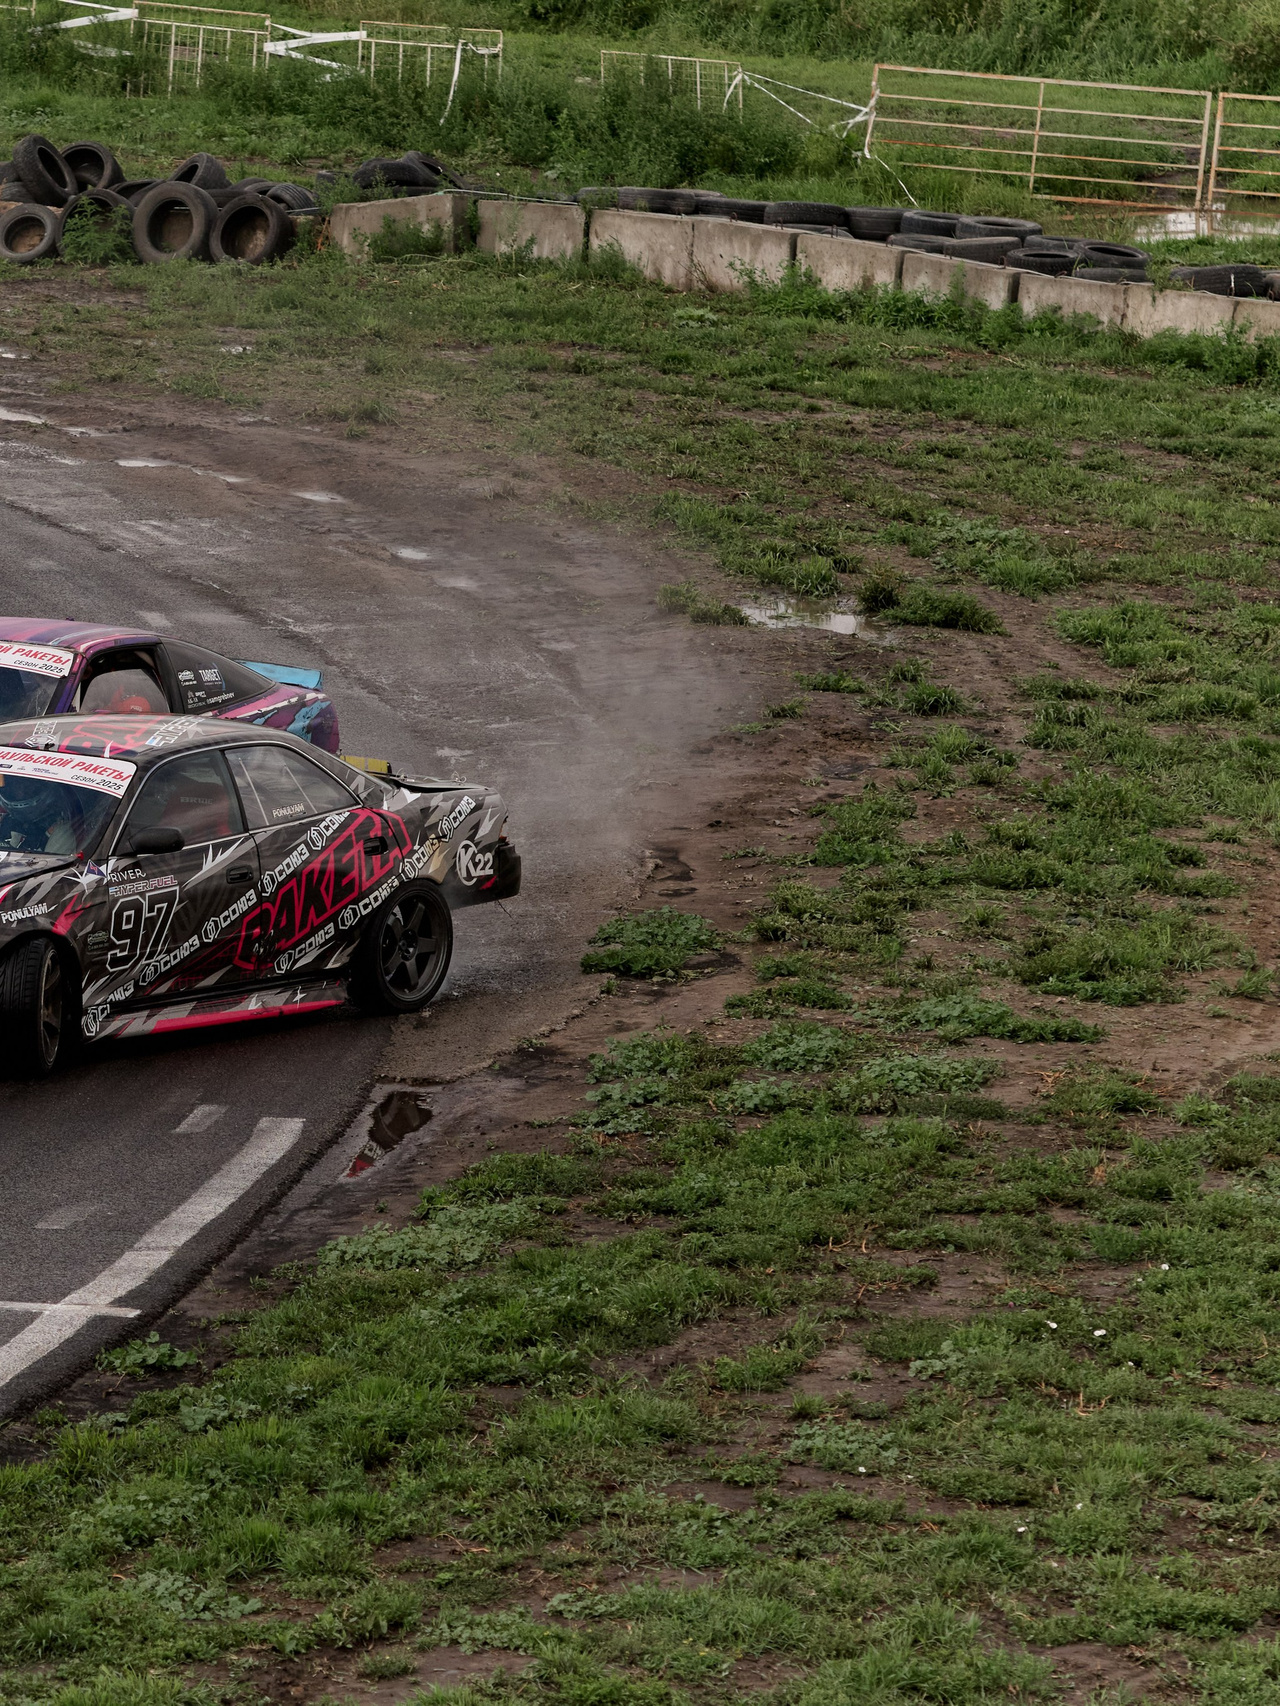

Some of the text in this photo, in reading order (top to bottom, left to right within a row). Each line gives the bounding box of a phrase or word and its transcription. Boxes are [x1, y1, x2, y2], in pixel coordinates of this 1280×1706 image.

[12, 647, 72, 665] РАКЕТЫ
[13, 660, 65, 674] СЕЗОН 2025
[71, 761, 133, 782] РАКЕТЫ
[70, 774, 124, 791] СЕЗОН 2025
[109, 874, 178, 897] HYPER FUEL
[110, 868, 147, 883] RIVER
[0, 903, 49, 924] PONULYAM
[158, 934, 200, 973] СОЮЗ
[219, 888, 258, 929] СОЮЗ
[275, 843, 310, 883] СОЮЗ
[106, 886, 180, 972] 97
